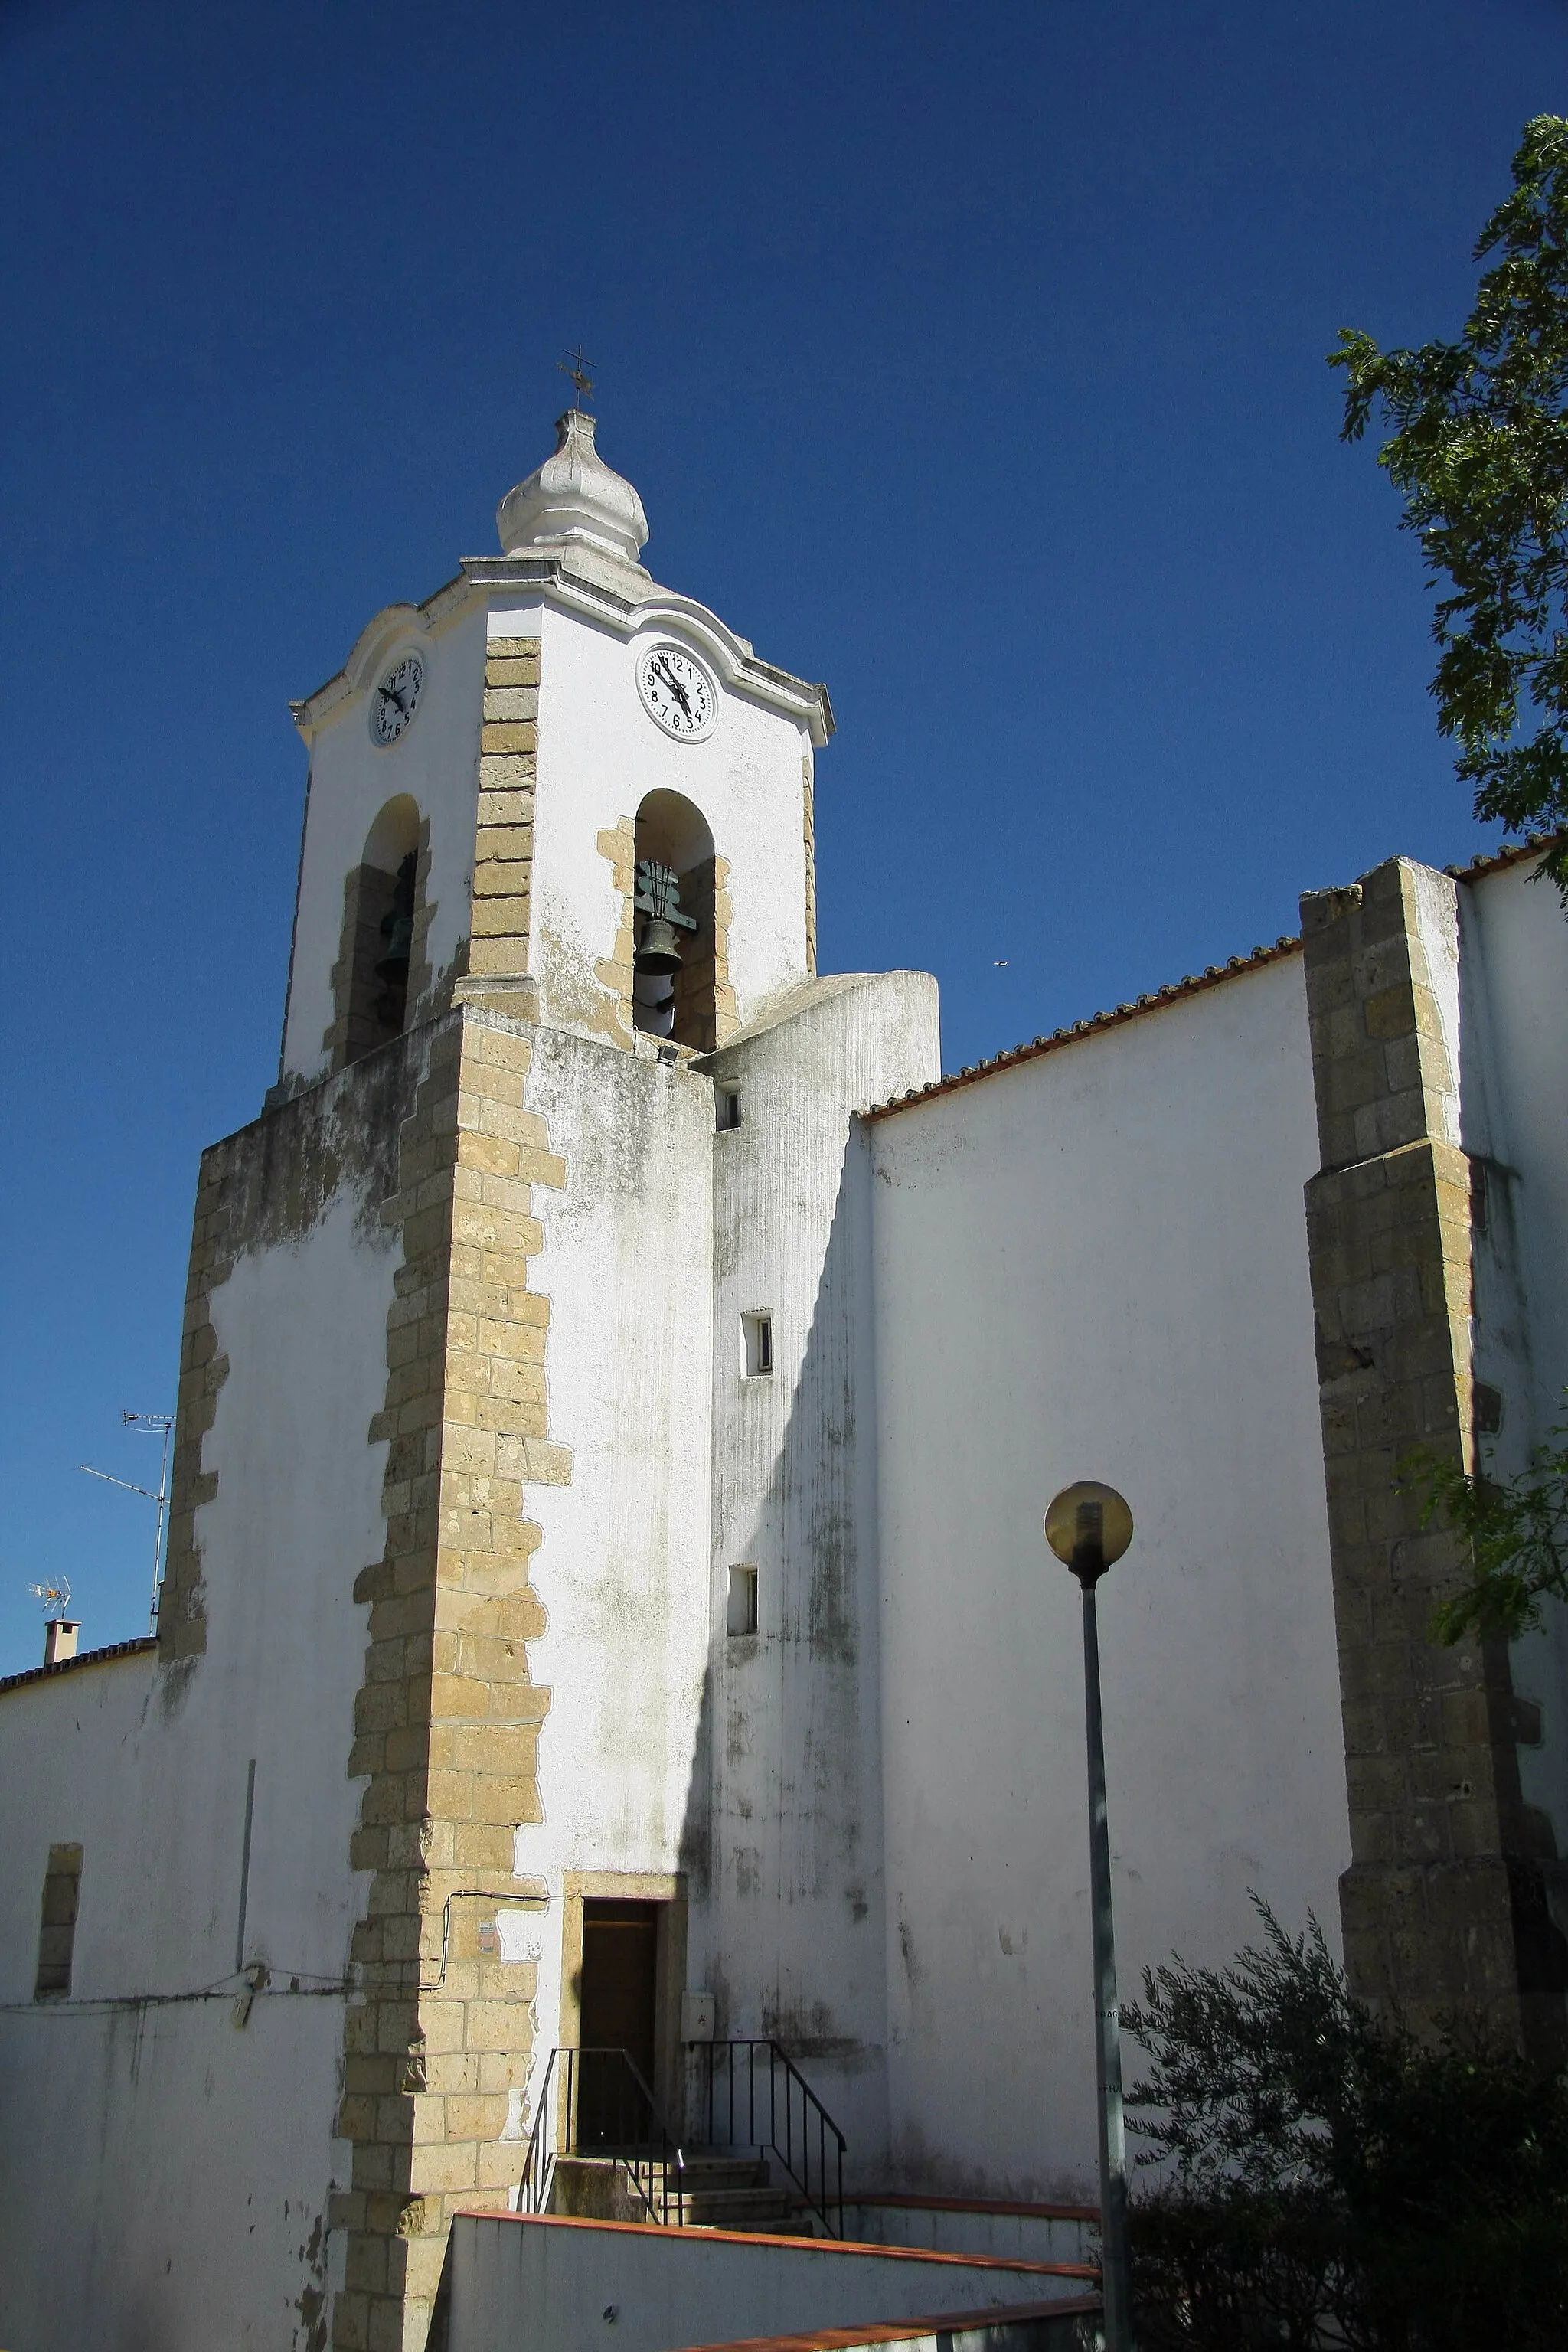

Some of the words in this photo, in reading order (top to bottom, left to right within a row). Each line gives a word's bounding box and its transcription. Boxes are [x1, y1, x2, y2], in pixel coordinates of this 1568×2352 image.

[408, 664, 412, 676] 1
[672, 657, 684, 673] 12
[398, 665, 406, 680] 12
[413, 668, 419, 682] 2
[688, 668, 692, 680] 1
[648, 674, 655, 686] 9
[414, 680, 420, 694] 3
[696, 682, 703, 695] 2
[410, 697, 416, 709] 4
[651, 690, 658, 703] 8
[700, 697, 706, 710] 3
[381, 707, 386, 721] 9
[662, 704, 668, 717] 7
[694, 710, 701, 723] 4
[404, 711, 410, 726] 5
[673, 714, 680, 727] 6
[687, 716, 694, 729] 5
[381, 720, 387, 733] 8
[387, 724, 393, 739] 7
[395, 723, 400, 736] 6
